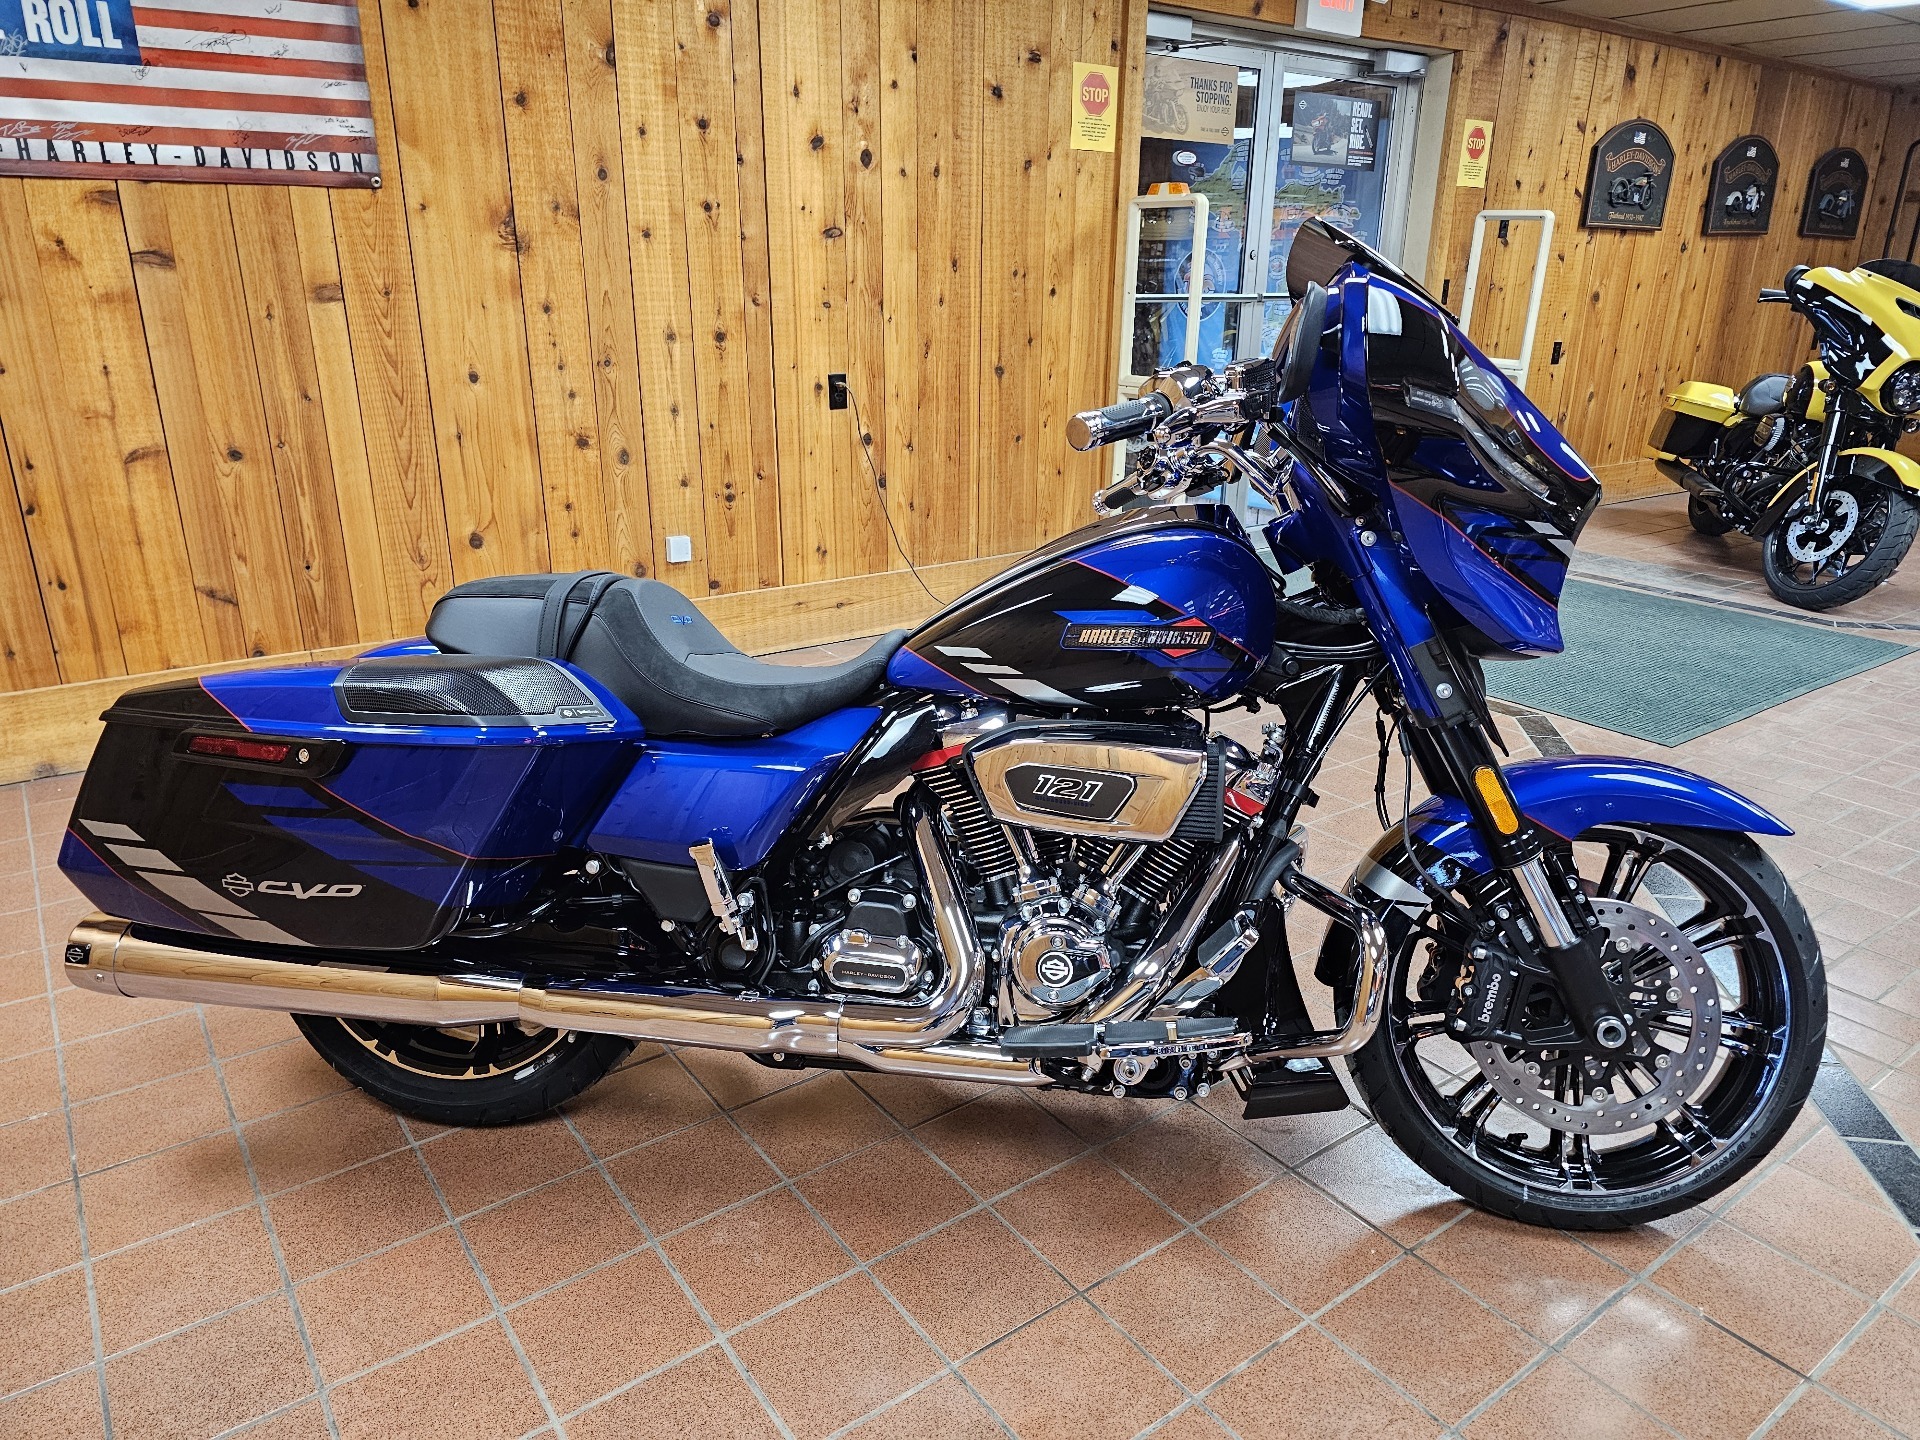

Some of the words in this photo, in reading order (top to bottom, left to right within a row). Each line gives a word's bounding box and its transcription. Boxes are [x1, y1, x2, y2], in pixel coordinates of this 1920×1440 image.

[21, 0, 123, 49] ROLL
[1190, 76, 1218, 92] THANKS
[1219, 80, 1233, 94] FOR
[1082, 86, 1109, 103] STOP
[1195, 90, 1232, 107] STOPPING.
[1352, 101, 1373, 119] READY.
[1350, 117, 1364, 134] SET.
[1348, 133, 1366, 150] RIDE.
[1467, 137, 1485, 150] STOP
[15, 136, 365, 173] HARLEY-DAVIDSON
[1611, 150, 1660, 174] HARLEY-DAVIDSON
[1033, 774, 1103, 802] 121
[257, 880, 363, 900] CVO
[841, 970, 896, 980] HARLEY-DAVIDSON
[1477, 973, 1502, 1023] brembo
[1691, 1140, 1747, 1185] DUNLOP
